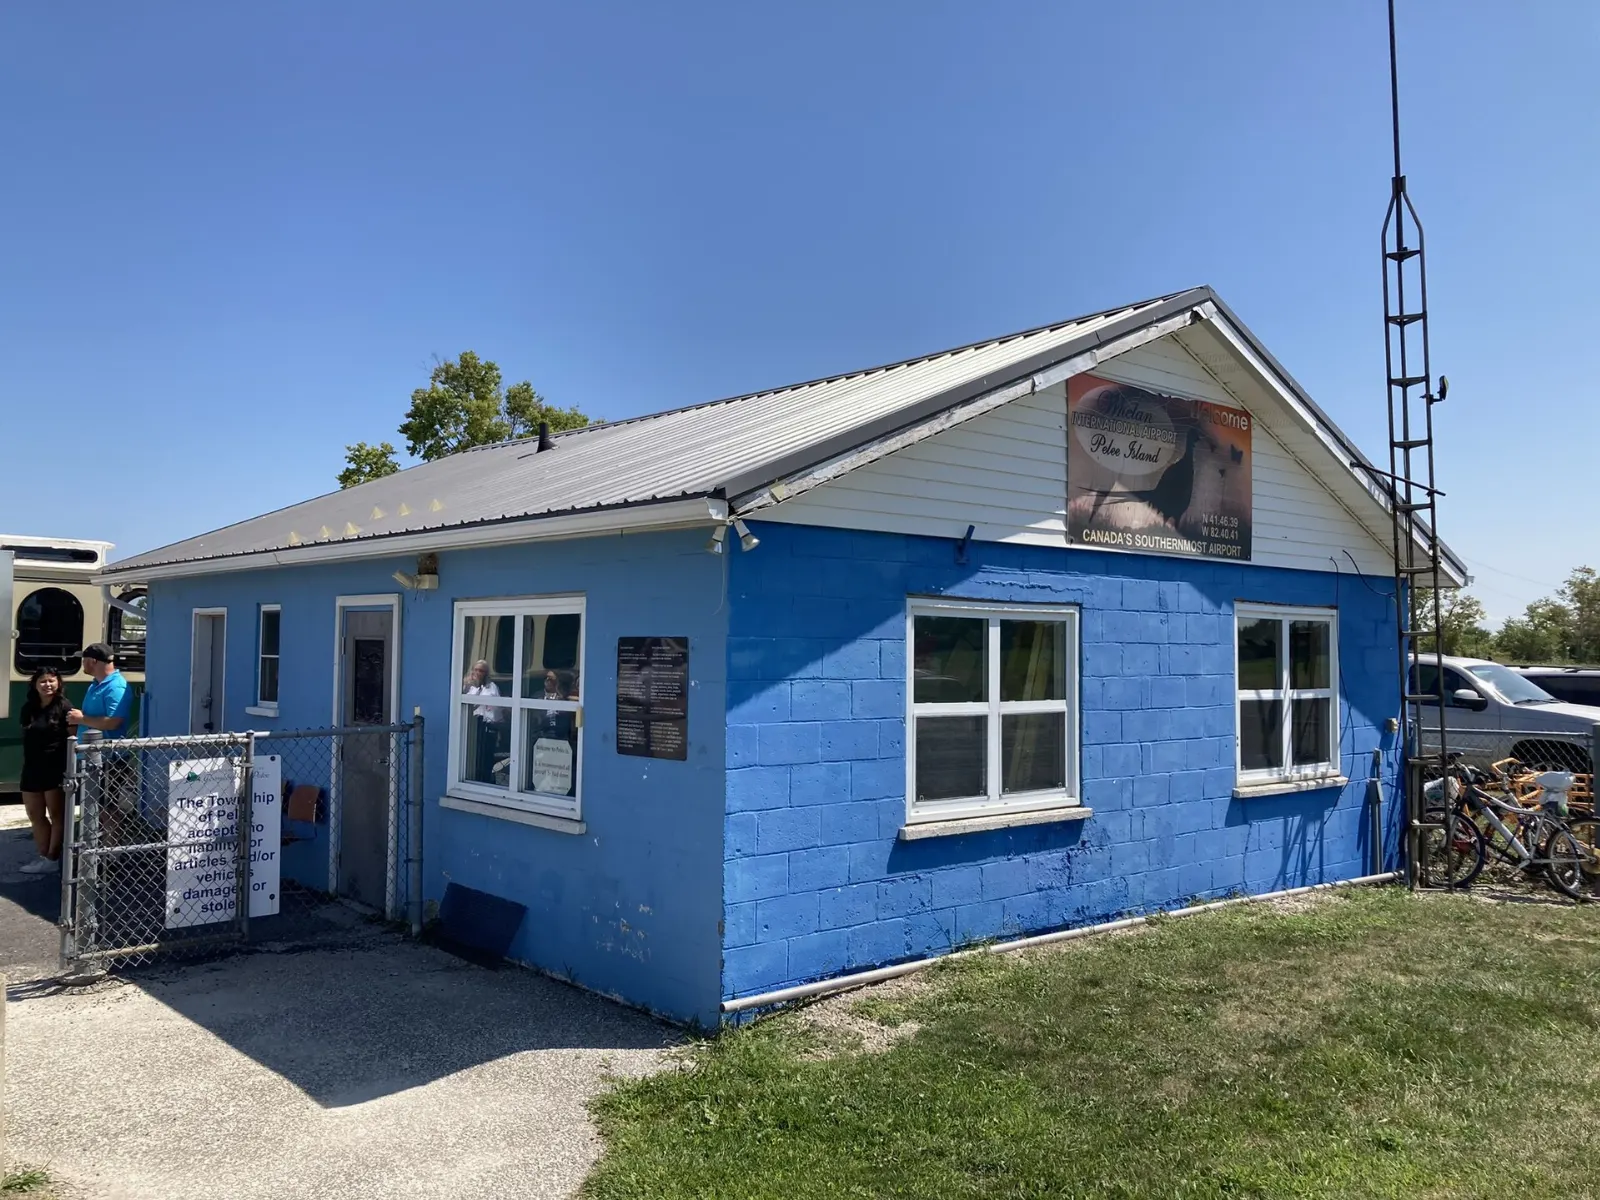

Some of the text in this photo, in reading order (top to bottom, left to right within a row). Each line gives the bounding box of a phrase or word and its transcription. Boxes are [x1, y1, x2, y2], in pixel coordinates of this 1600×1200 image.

[1071, 411, 1178, 444] INTERNATIONAL AIRPORT
[1090, 433, 1162, 464] Pelee Island
[1202, 513, 1239, 527] N 41.46.39
[1201, 526, 1239, 540] W 82.40.41
[1082, 529, 1242, 557] CANADA'S SOUTHERNMOST AIRPORT
[177, 792, 275, 809] The Townhip
[198, 809, 254, 822] of Pel
[187, 823, 240, 839] accepts
[249, 838, 263, 848] or
[174, 850, 275, 871] articles ad/or
[196, 868, 254, 883] vehicls
[182, 881, 267, 901] damage or
[201, 899, 237, 913] stole
